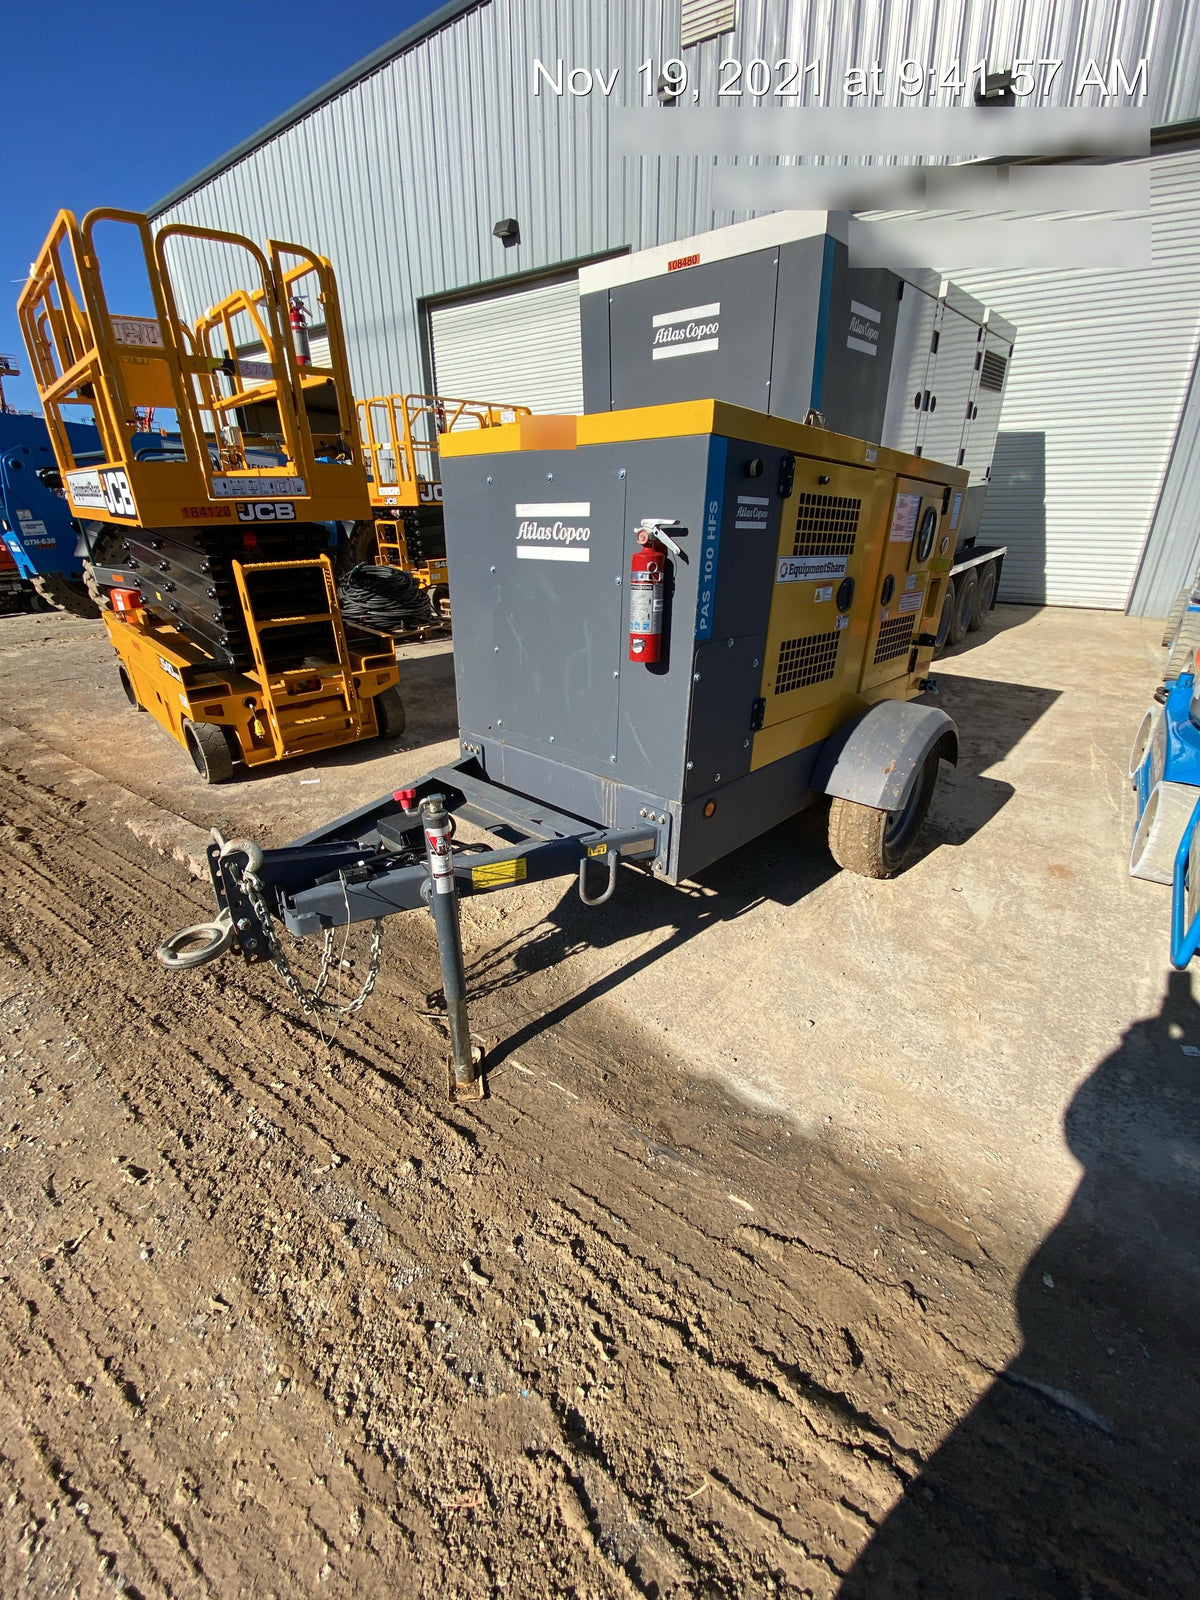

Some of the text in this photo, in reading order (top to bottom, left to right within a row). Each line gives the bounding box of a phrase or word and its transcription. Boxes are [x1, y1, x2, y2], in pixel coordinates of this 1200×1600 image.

[669, 255, 697, 271] 108480
[652, 322, 719, 345] Atlas Copco
[848, 316, 880, 341] Atlas Copco
[103, 471, 136, 515] JCB
[183, 506, 231, 518] 184120
[239, 502, 295, 521] JCB
[735, 506, 769, 520] Atlas Copco
[515, 521, 591, 545] Atlas Copco
[699, 500, 718, 630] PAS 100 HFS
[788, 561, 846, 577] EquipmentShare
